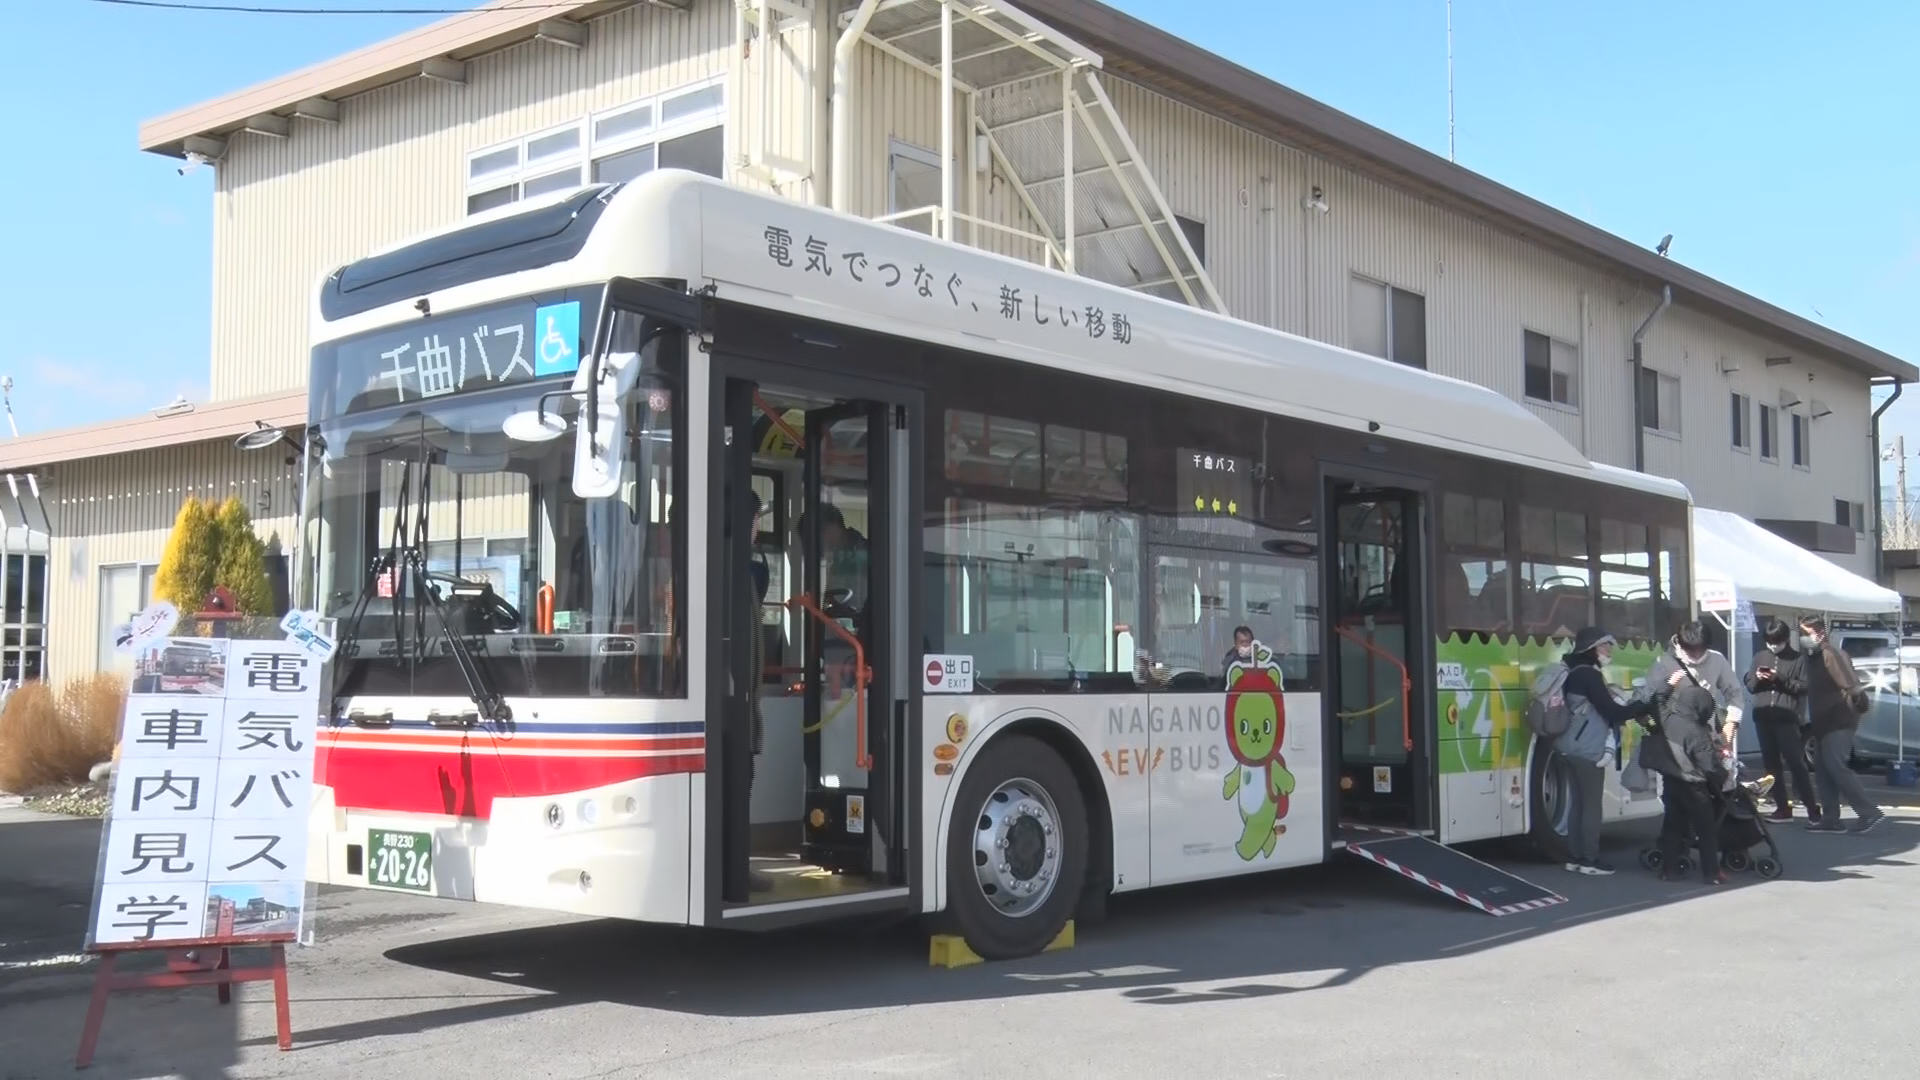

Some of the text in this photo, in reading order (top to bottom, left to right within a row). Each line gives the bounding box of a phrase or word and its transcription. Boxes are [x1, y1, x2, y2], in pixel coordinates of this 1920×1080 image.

[764, 225, 1132, 345] 電気でつなぐ、新しい移動
[380, 324, 534, 402] 千曲バス
[1193, 454, 1235, 473] 千曲バス
[945, 659, 970, 674] 出口
[948, 679, 967, 688] EXIT
[1108, 705, 1220, 735] NAGANO
[226, 652, 308, 871] 電気バス
[1117, 745, 1220, 776] EV BUS
[112, 709, 209, 941] 車内見学
